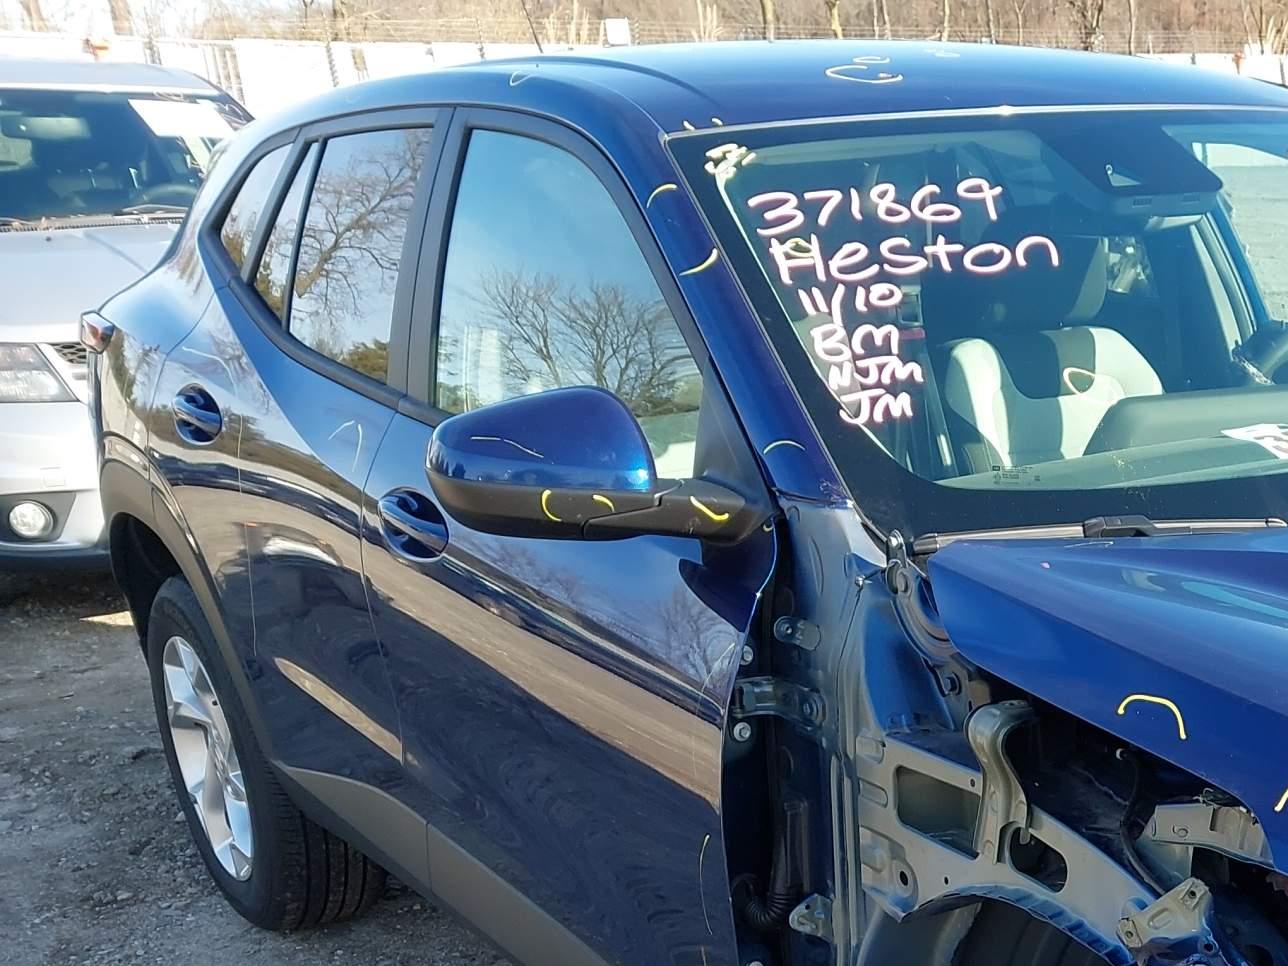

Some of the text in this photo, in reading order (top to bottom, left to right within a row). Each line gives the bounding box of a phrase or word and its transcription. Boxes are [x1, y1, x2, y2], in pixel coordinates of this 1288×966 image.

[747, 177, 1003, 236] 371869
[768, 233, 1060, 285] Heston
[797, 282, 903, 325] 11/10
